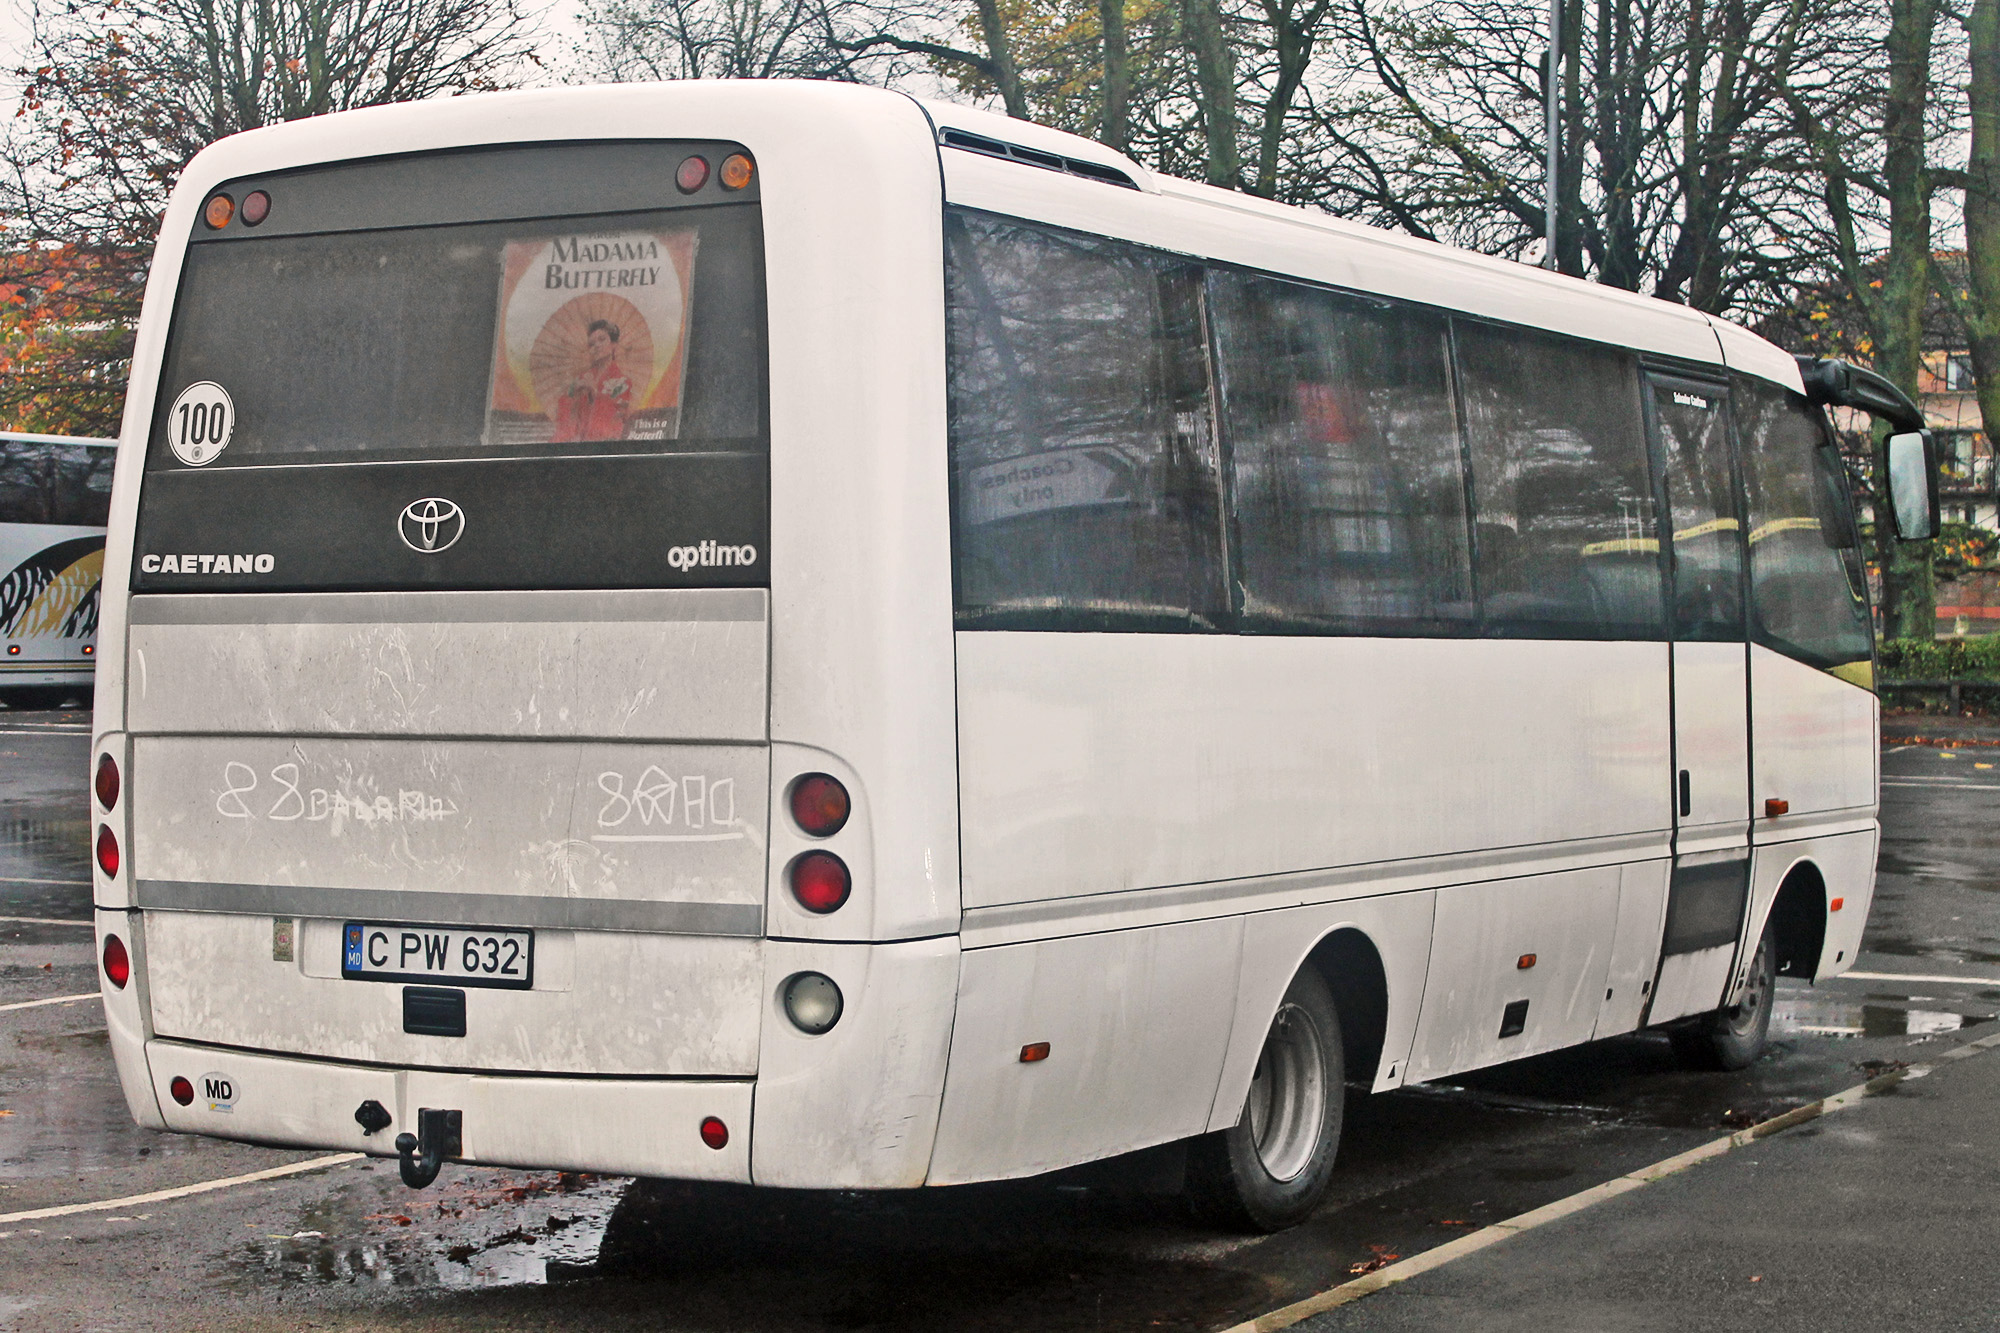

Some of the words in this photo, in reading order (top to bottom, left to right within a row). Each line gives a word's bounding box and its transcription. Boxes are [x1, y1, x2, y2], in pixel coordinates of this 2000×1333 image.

[551, 236, 658, 263] MADAMA
[544, 264, 661, 289] BUTTERFLY
[179, 402, 225, 445] 100
[141, 554, 275, 574] CAETANO
[667, 540, 757, 572] optimo
[347, 952, 361, 966] MD
[368, 931, 389, 967] C
[400, 932, 449, 971] PW
[462, 936, 520, 975] 632
[205, 1078, 232, 1100] MD
